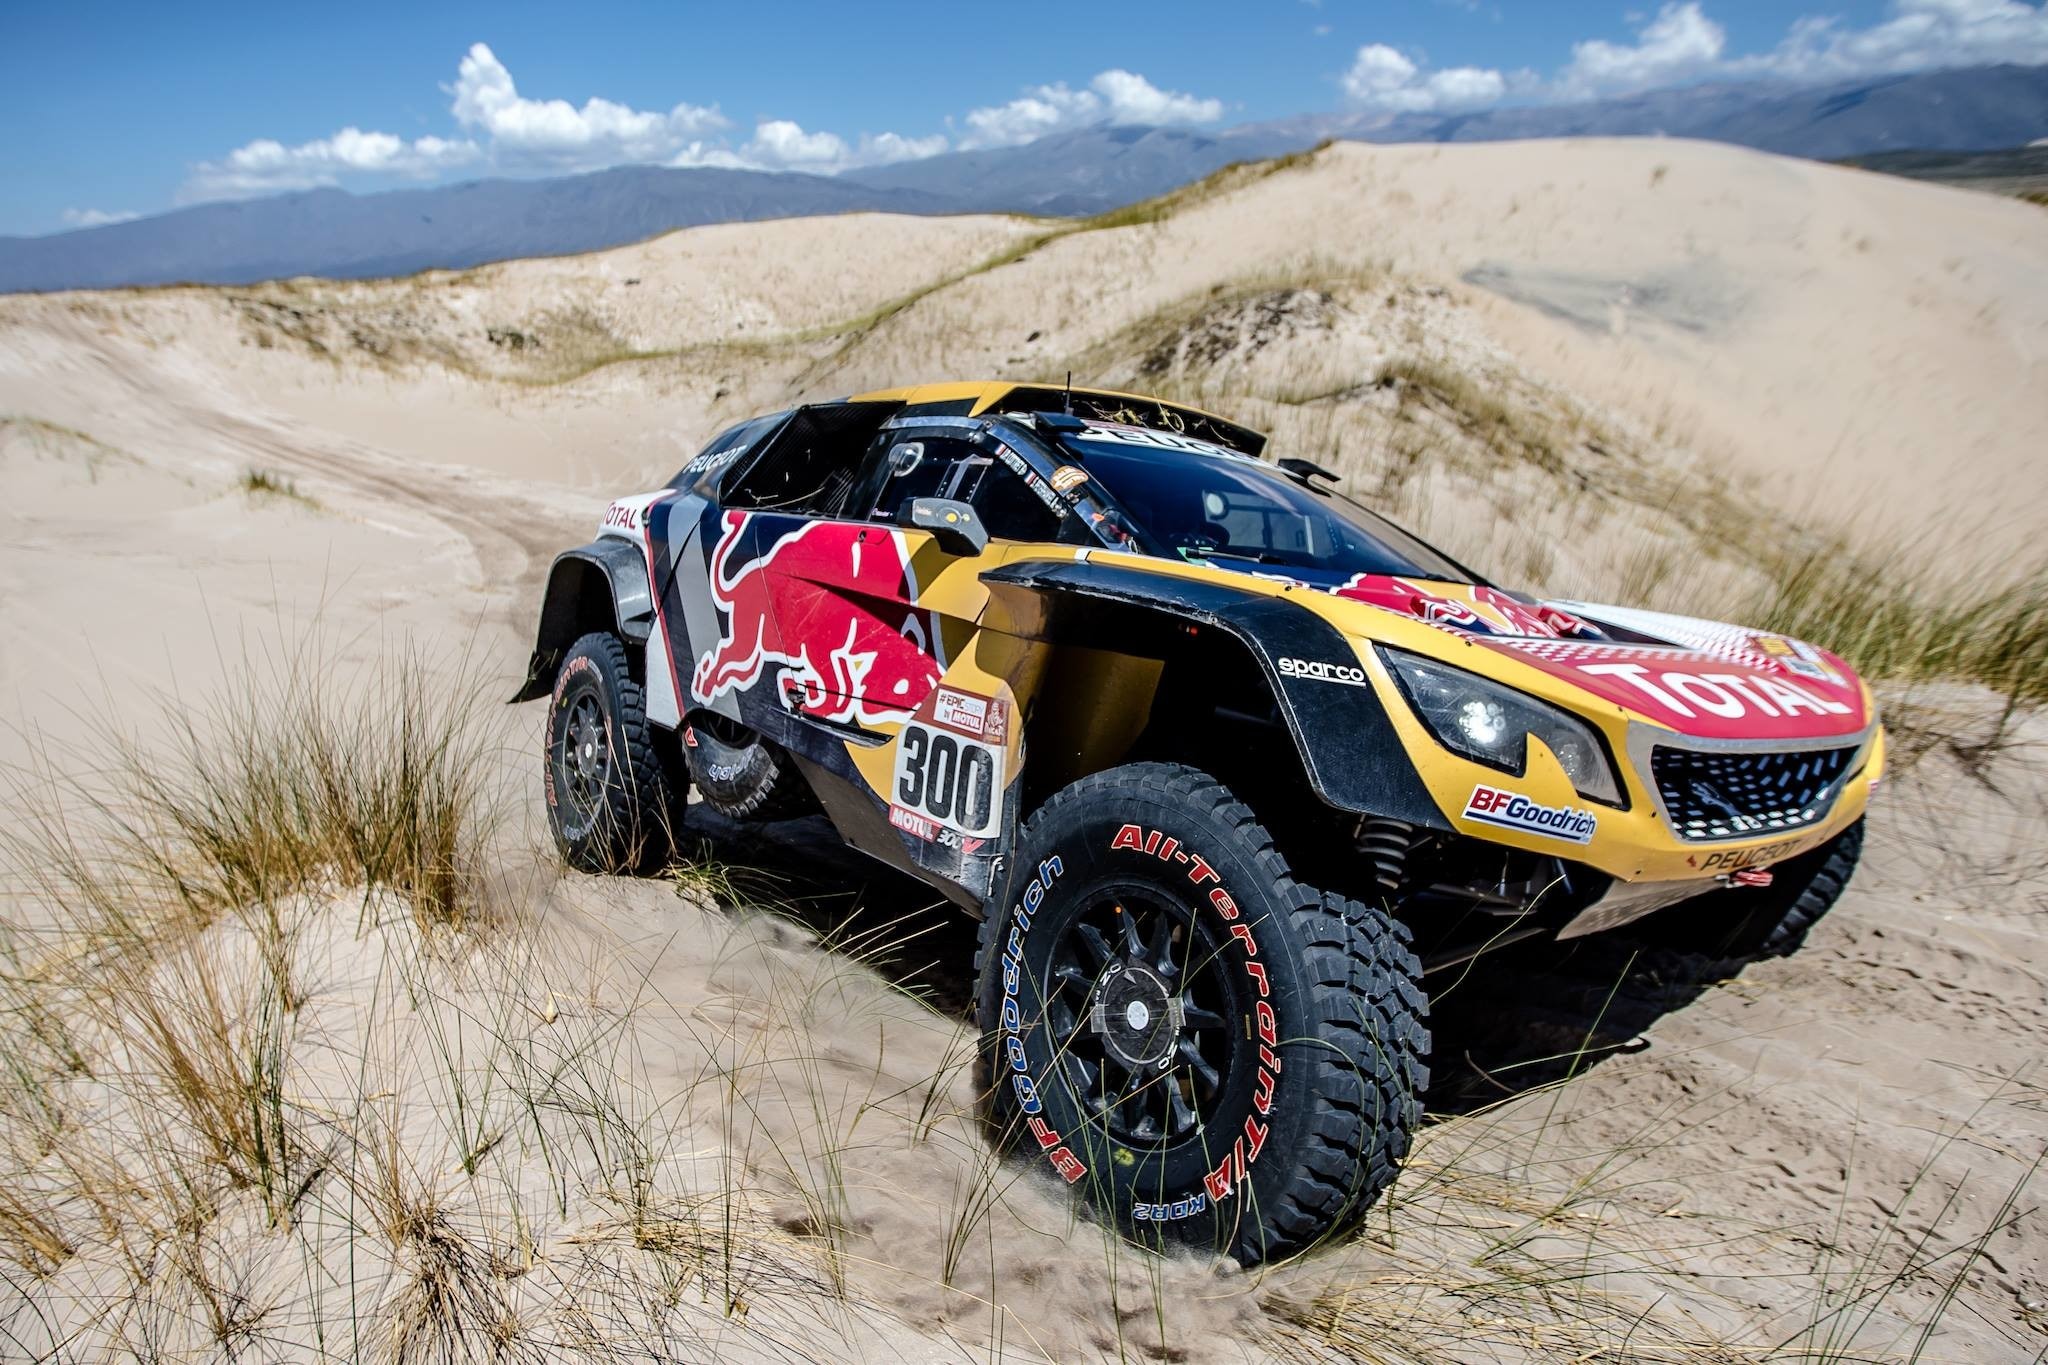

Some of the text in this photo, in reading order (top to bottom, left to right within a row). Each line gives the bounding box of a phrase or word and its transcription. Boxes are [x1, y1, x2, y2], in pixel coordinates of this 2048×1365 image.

[1278, 656, 1365, 682] sparco
[1576, 661, 1854, 719] TOTAL
[953, 712, 980, 728] MOTUL
[900, 726, 994, 832] 300
[892, 808, 986, 854] MOTUL 300V
[1468, 786, 1598, 838] BFGoodrich
[1700, 839, 1803, 871] PEUGEOT
[1111, 824, 1282, 1115] All-Terrain
[1001, 855, 1088, 1183] BFGoodrich
[1132, 1192, 1206, 1222] KDR2
